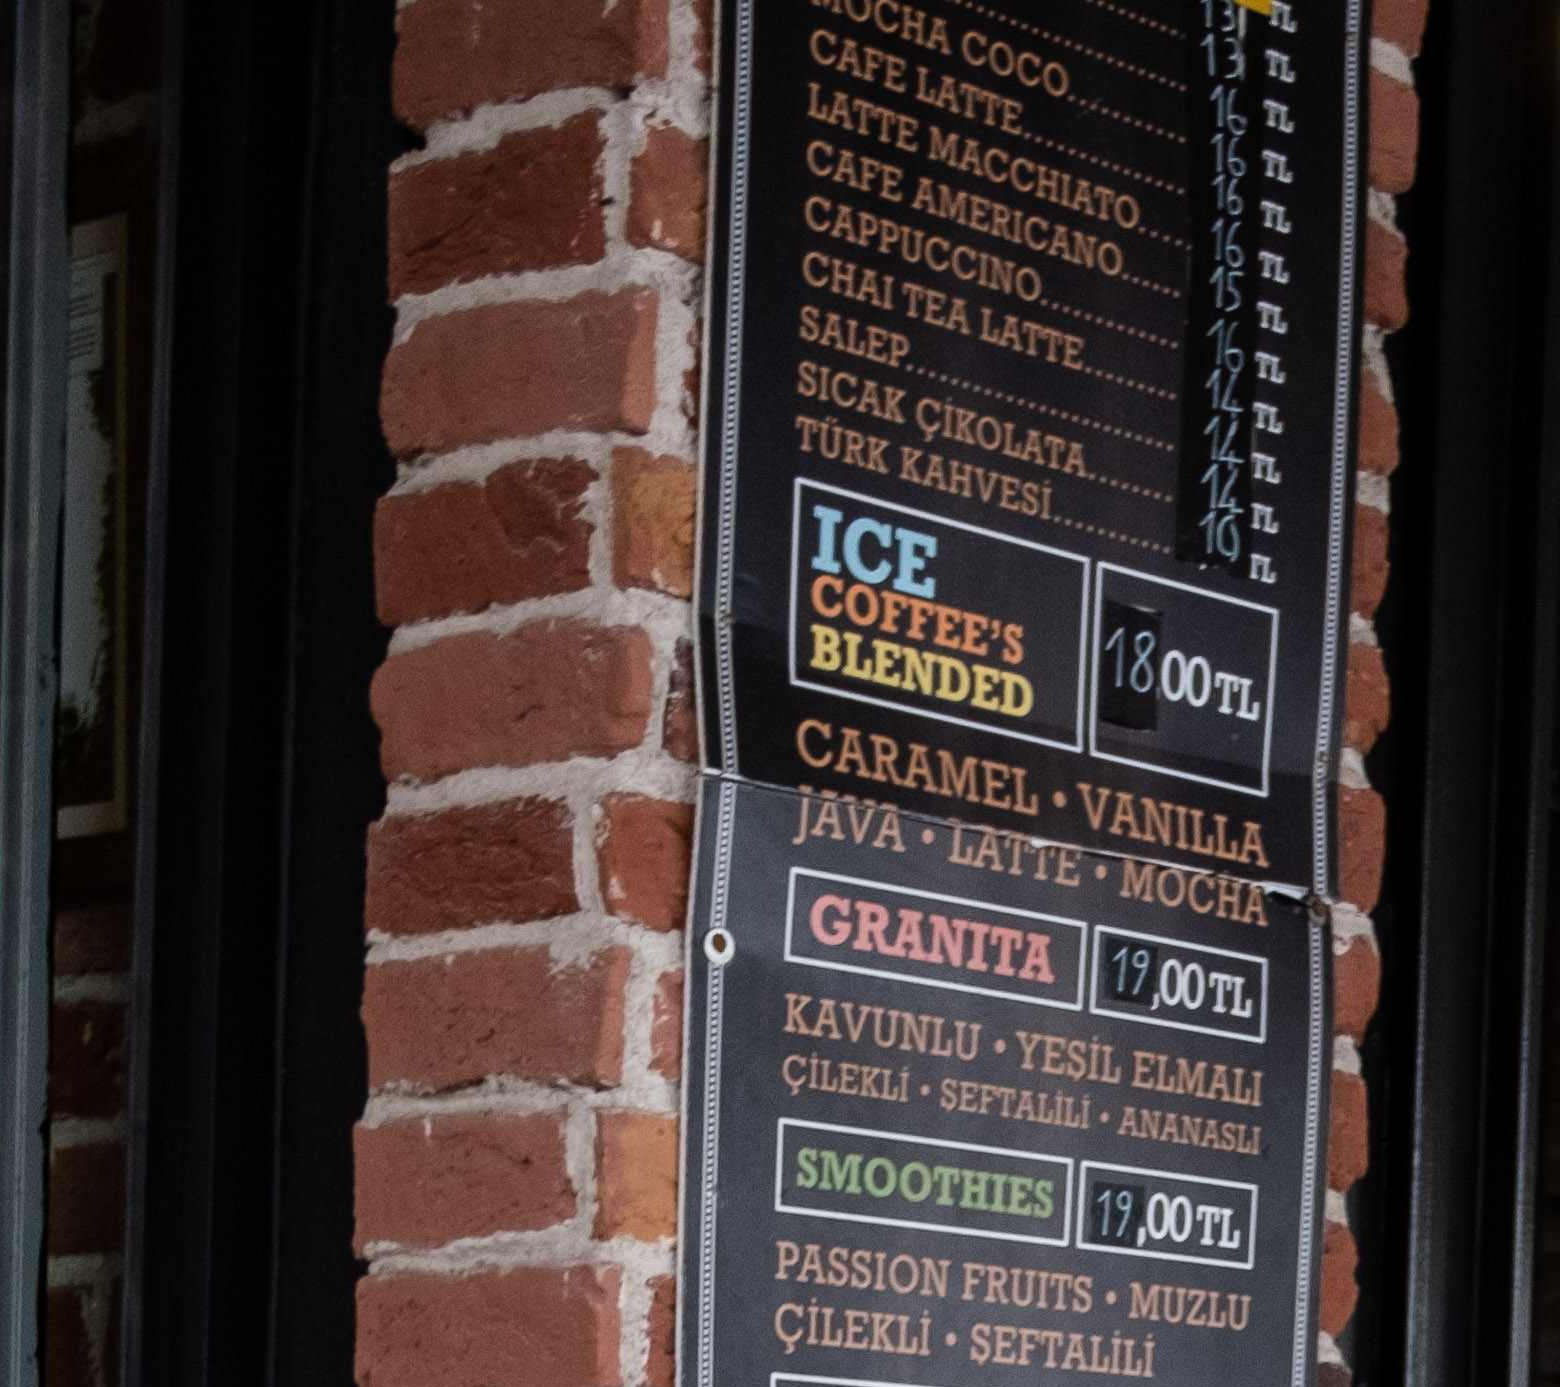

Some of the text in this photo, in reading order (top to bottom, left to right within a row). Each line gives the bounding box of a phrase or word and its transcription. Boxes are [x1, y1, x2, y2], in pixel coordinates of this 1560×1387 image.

[962, 30, 1070, 98] COCO
[1261, 149, 1294, 184] TL
[1262, 99, 1295, 134] TL
[1265, 49, 1296, 83] TL
[806, 82, 920, 153] LATTE
[928, 126, 1141, 230] MACCHIATO
[1257, 251, 1291, 285] TL
[809, 28, 907, 92] CAFE
[915, 65, 1026, 136] LATTE
[1259, 200, 1292, 234] TL
[803, 196, 1042, 302] CAPPUCCINO
[1253, 351, 1288, 385] TL
[805, 140, 903, 202] CAFE
[911, 177, 1124, 277] AMERICANO
[1255, 301, 1289, 335] TL
[798, 304, 911, 369] SALEP
[1250, 451, 1283, 485] TL
[801, 250, 895, 312] CHAI
[902, 281, 971, 335] TEA
[980, 306, 1086, 373] LATTE
[1251, 401, 1285, 435] TL
[794, 414, 890, 476] TÜRK
[899, 446, 1055, 522] KAHVESİ
[1248, 552, 1278, 585] TL
[796, 361, 908, 425] SICAK
[915, 388, 1090, 479] ÇİKOLATA
[1249, 502, 1280, 535] TL
[811, 504, 938, 600] ICE
[810, 574, 1025, 665] COFFEE'S
[810, 623, 1035, 719] BLENDED
[792, 785, 1270, 928] JAVA LATTE MOCHA
[796, 718, 1270, 868] CARAMEL VANILLA
[808, 893, 1056, 985] GRANITA
[781, 1053, 1262, 1156] ÇİLEKLİ ŞEFTALİLİ ANANASLI
[784, 992, 1264, 1108] KAVUNLU YEŞİL ELMALI
[795, 1146, 1056, 1219] SMOOTHIES
[774, 1240, 1253, 1331] PASSION FRUITS MUZLU
[774, 1298, 1158, 1378] ÇİLEKLİ ŞEFTALİLİ
